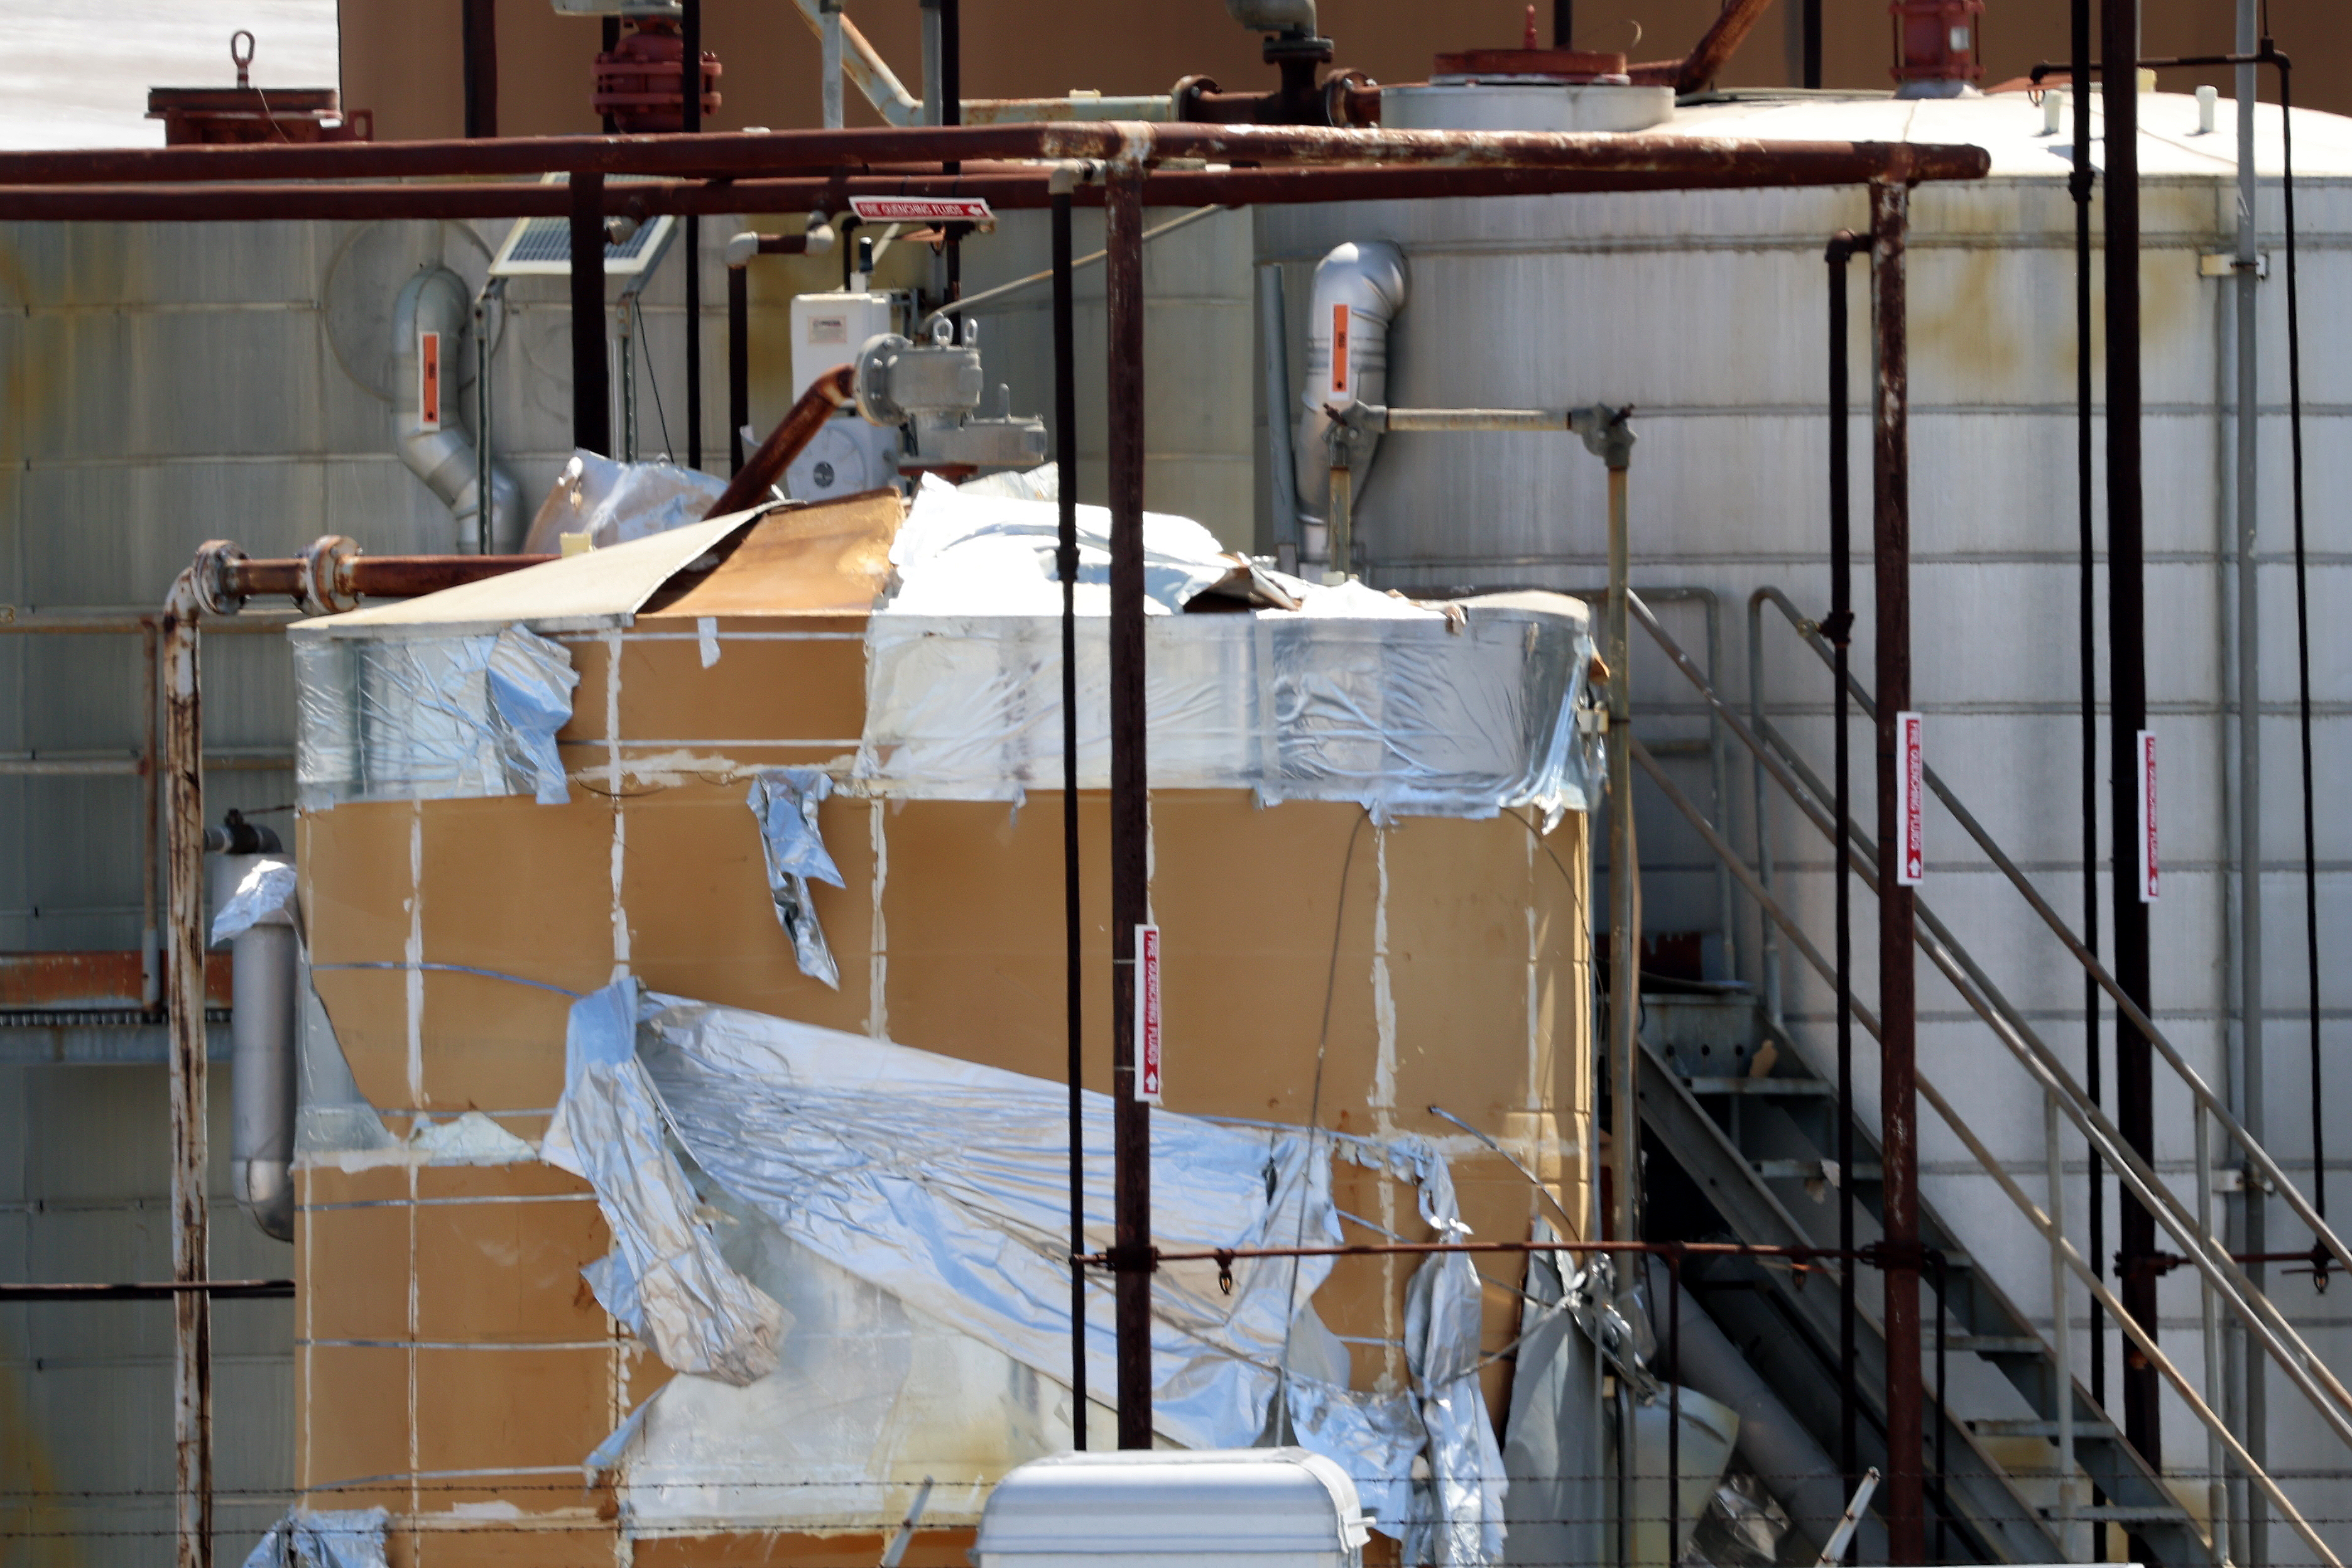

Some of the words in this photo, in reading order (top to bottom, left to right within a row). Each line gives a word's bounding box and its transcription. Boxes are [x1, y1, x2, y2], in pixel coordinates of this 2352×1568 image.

[859, 203, 881, 215] FIRE
[881, 203, 932, 215] QUENCHING
[932, 204, 964, 215] FLUIDS
[1909, 722, 1920, 746] FIRE
[2147, 740, 2155, 762] FIRE
[1909, 749, 1920, 812] QUENCHING
[1910, 814, 1920, 850] FLUIDS
[2149, 831, 2157, 868] FLUIDS
[1147, 934, 1157, 959] FIRE
[1147, 961, 1157, 1023] QUENCHING
[1148, 1027, 1158, 1065] FLUIDS
